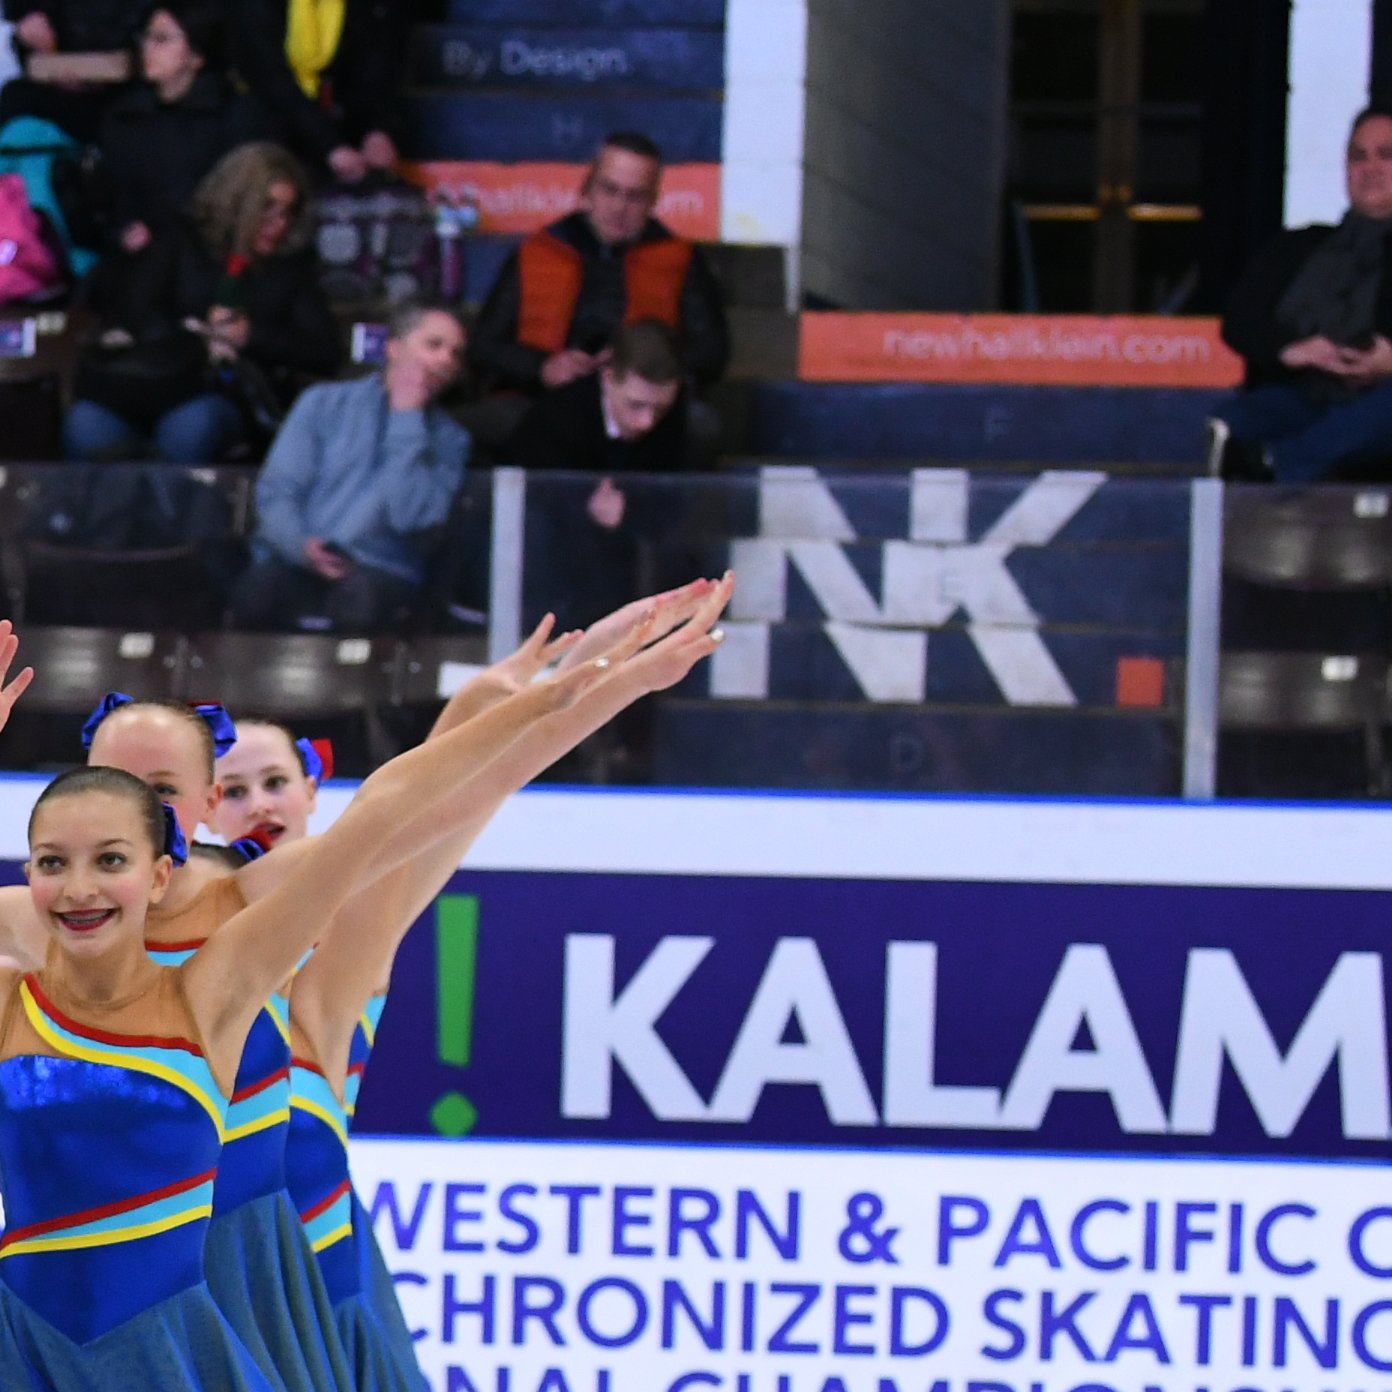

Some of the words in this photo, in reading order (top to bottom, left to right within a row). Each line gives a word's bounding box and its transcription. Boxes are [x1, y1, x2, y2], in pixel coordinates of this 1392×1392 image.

[442, 40, 493, 80] By
[882, 327, 1210, 363] newhallklein.com
[711, 466, 1108, 708] NK
[561, 933, 1391, 1140] KALAM
[369, 1181, 800, 1262] WESTERN
[837, 1192, 900, 1265] &
[937, 1195, 1317, 1277] PACIFIC
